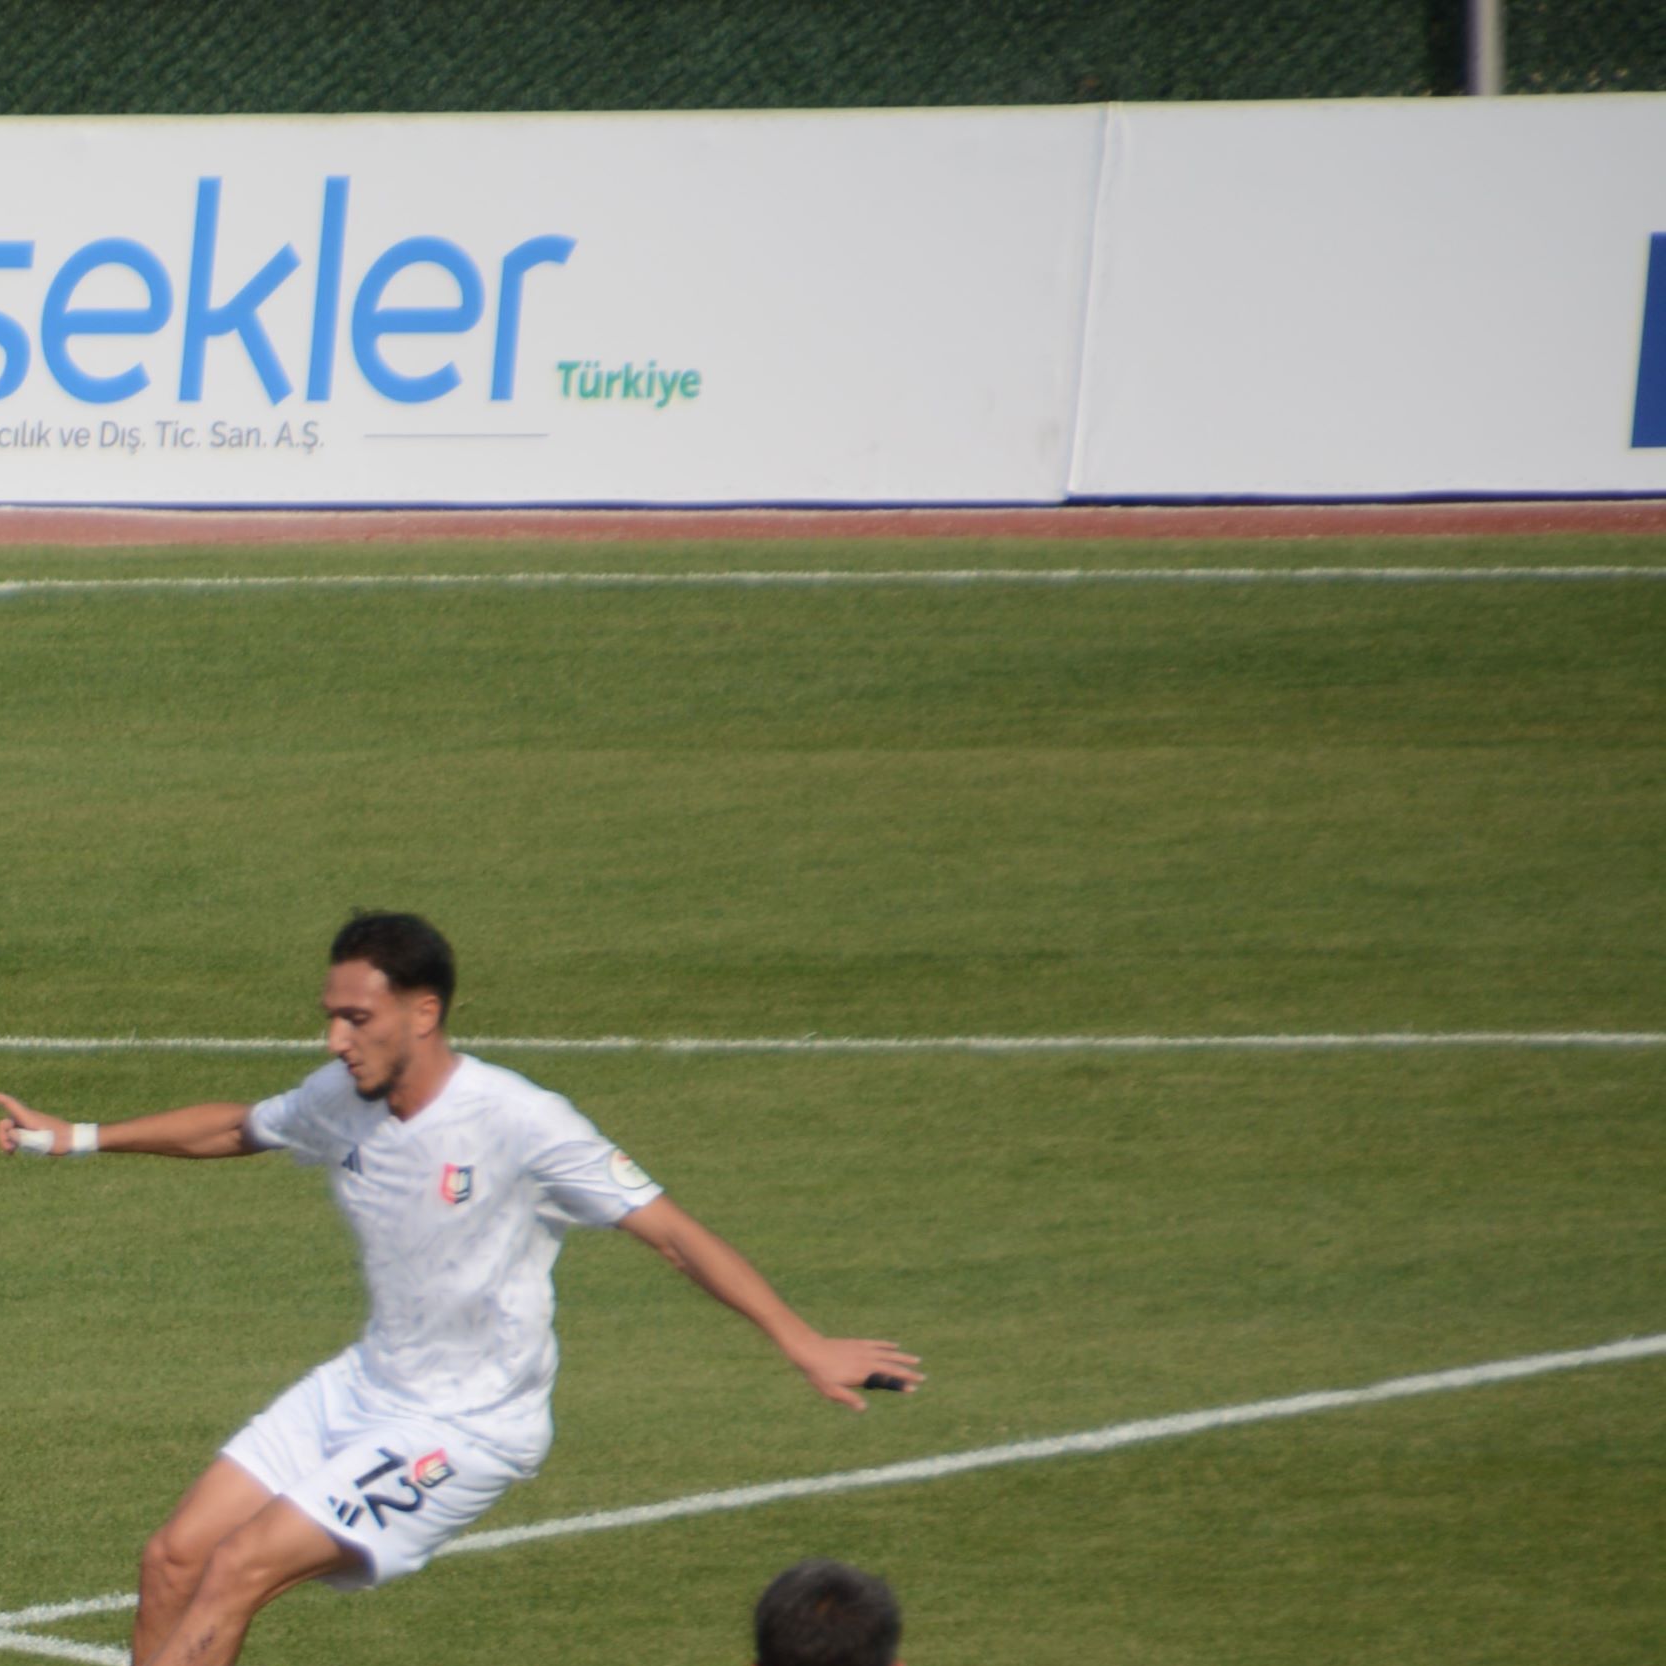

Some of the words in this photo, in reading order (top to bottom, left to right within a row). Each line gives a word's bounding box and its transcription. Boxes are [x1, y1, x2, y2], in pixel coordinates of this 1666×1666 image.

[556, 360, 701, 409] Türkiye
[59, 426, 91, 448] ve
[99, 420, 146, 455] Dış.
[155, 420, 201, 448] Tic.
[209, 420, 267, 448] San.
[274, 420, 325, 455] A.Ş.
